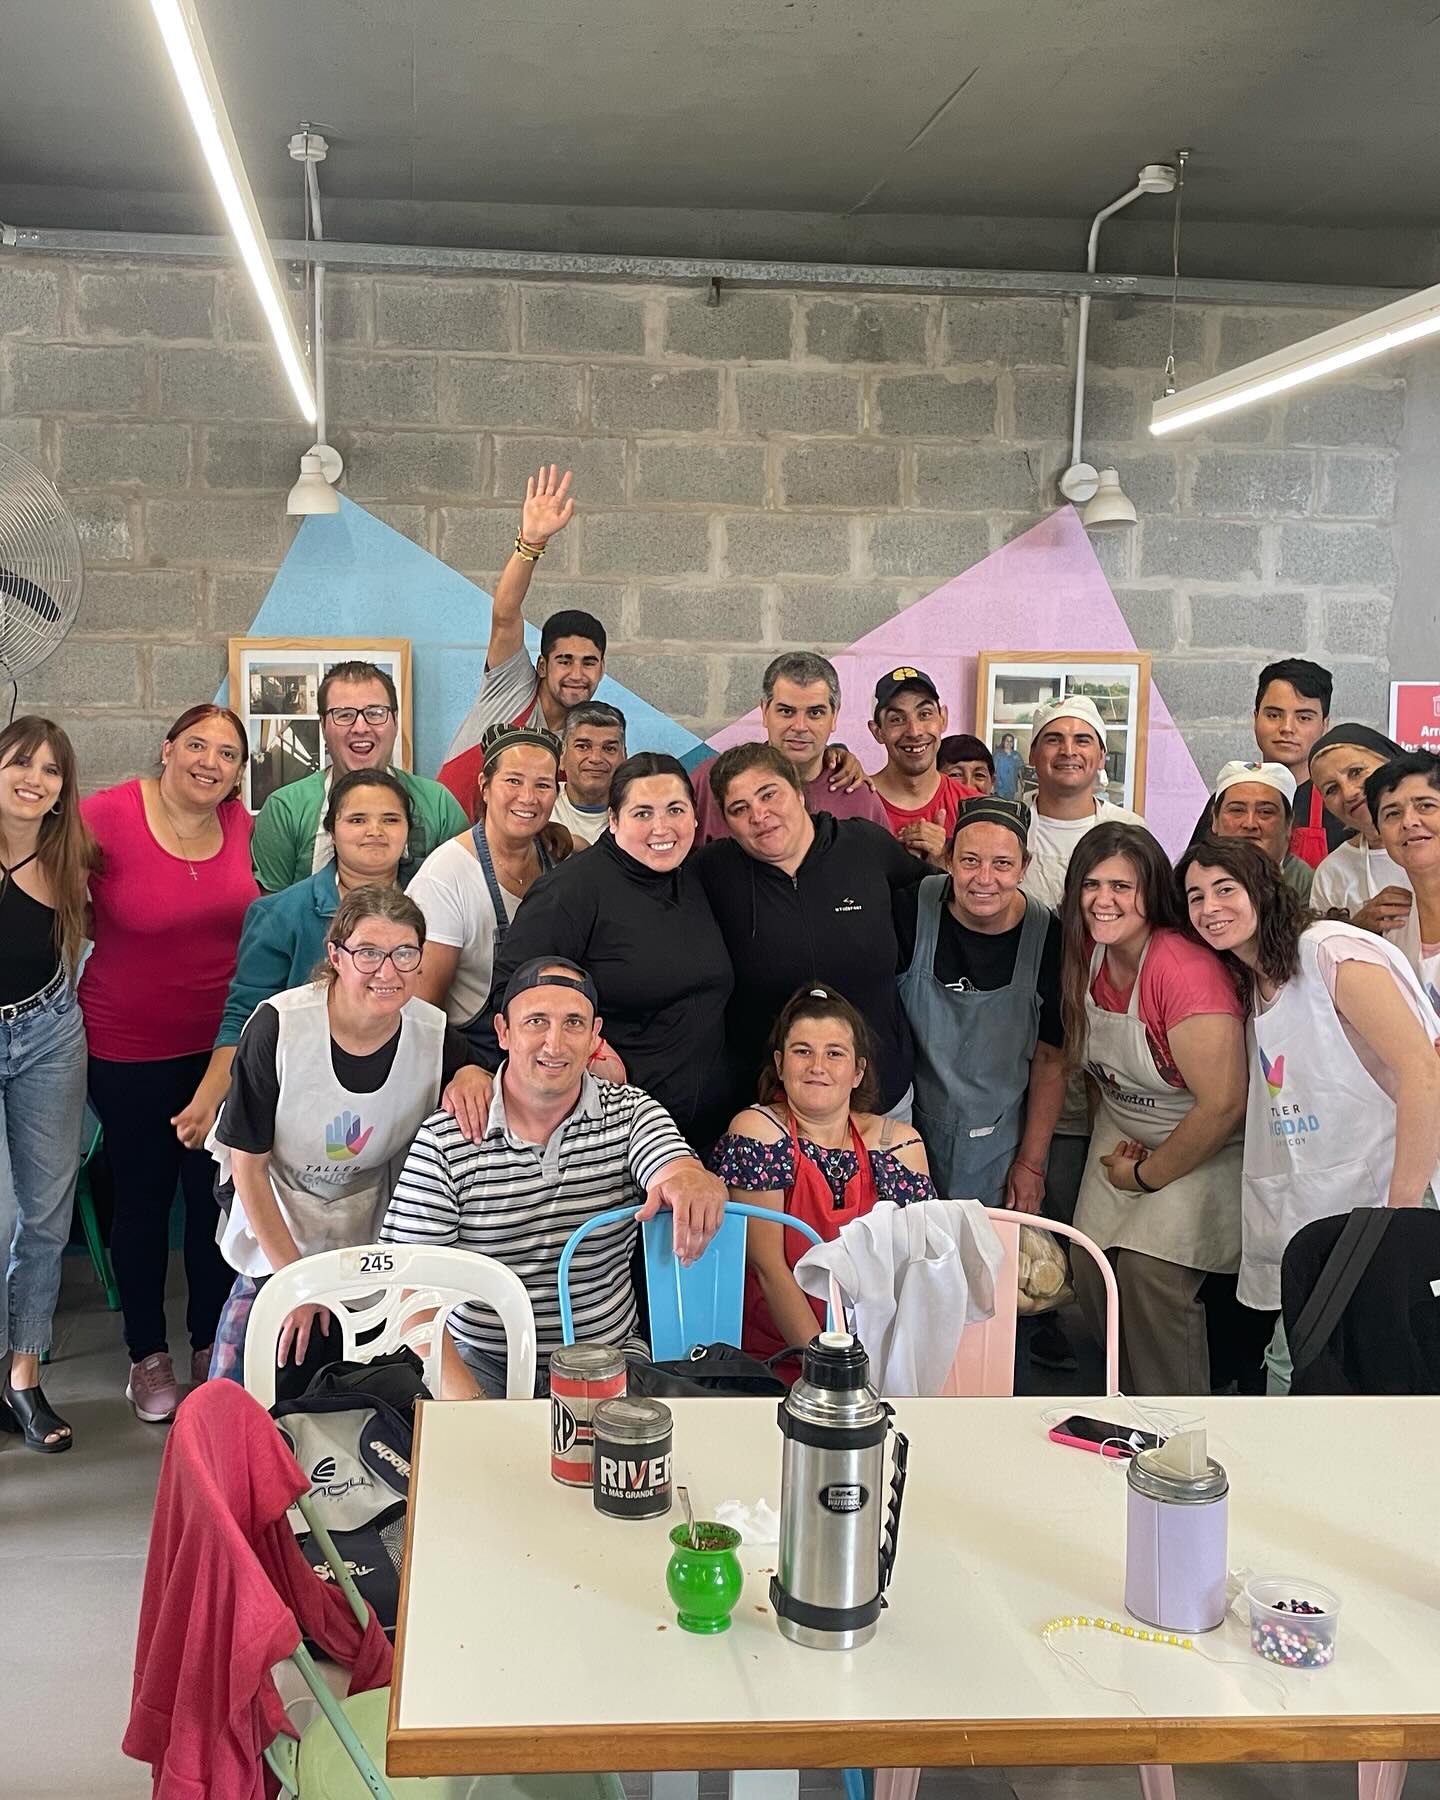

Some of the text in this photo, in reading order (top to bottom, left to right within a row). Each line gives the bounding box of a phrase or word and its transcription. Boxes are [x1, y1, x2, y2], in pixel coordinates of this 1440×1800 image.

[360, 1255, 394, 1271] 245
[600, 1452, 672, 1490] RIVER
[625, 1488, 654, 1499] GRANDE
